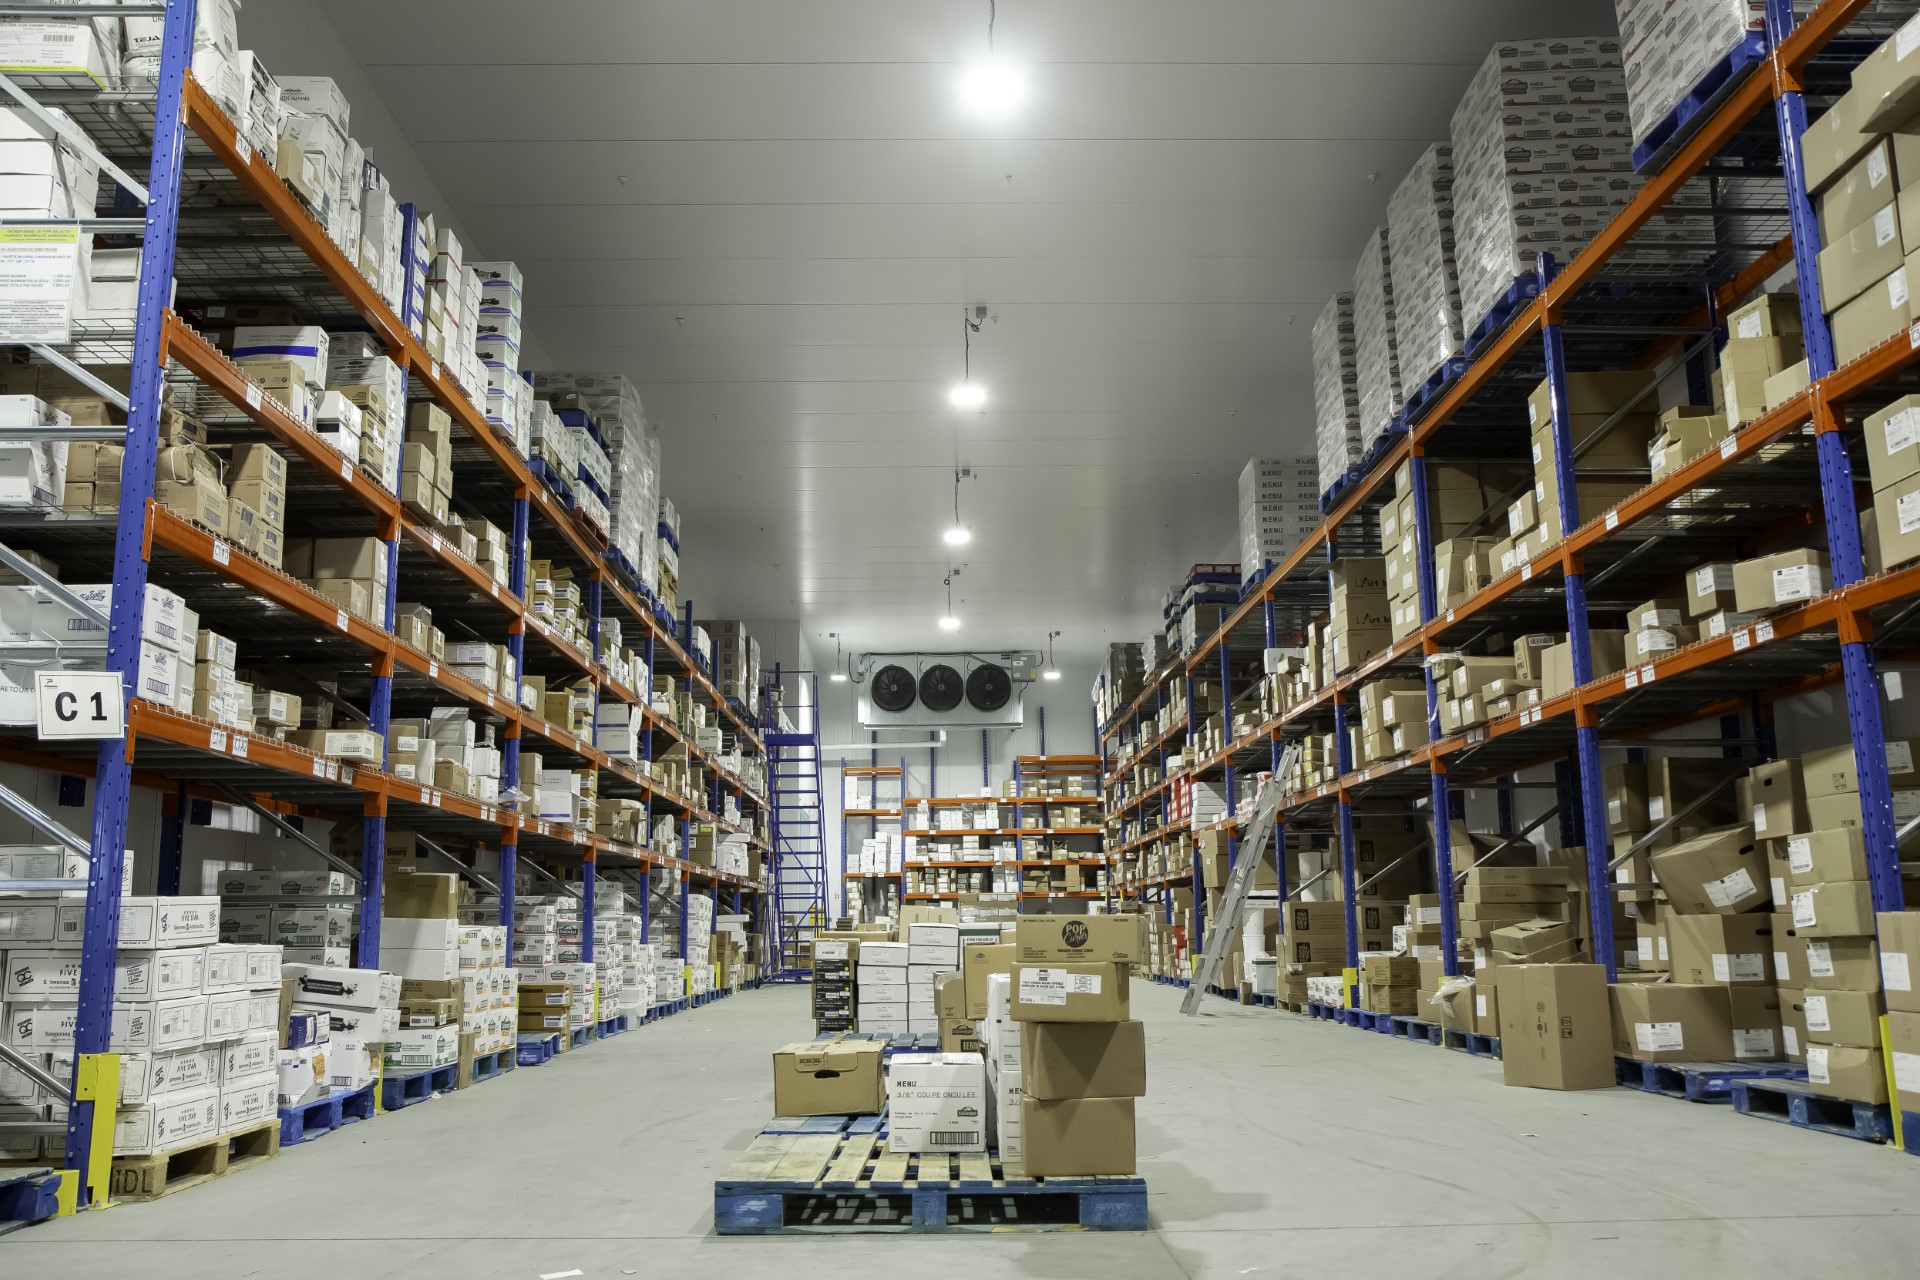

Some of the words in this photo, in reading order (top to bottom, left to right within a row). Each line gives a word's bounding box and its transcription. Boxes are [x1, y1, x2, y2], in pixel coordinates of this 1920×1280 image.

[1, 685, 30, 694] RETOUR
[55, 691, 78, 721] C
[90, 691, 108, 721] 1
[1066, 924, 1085, 934] POP
[115, 1169, 152, 1194] IDL
